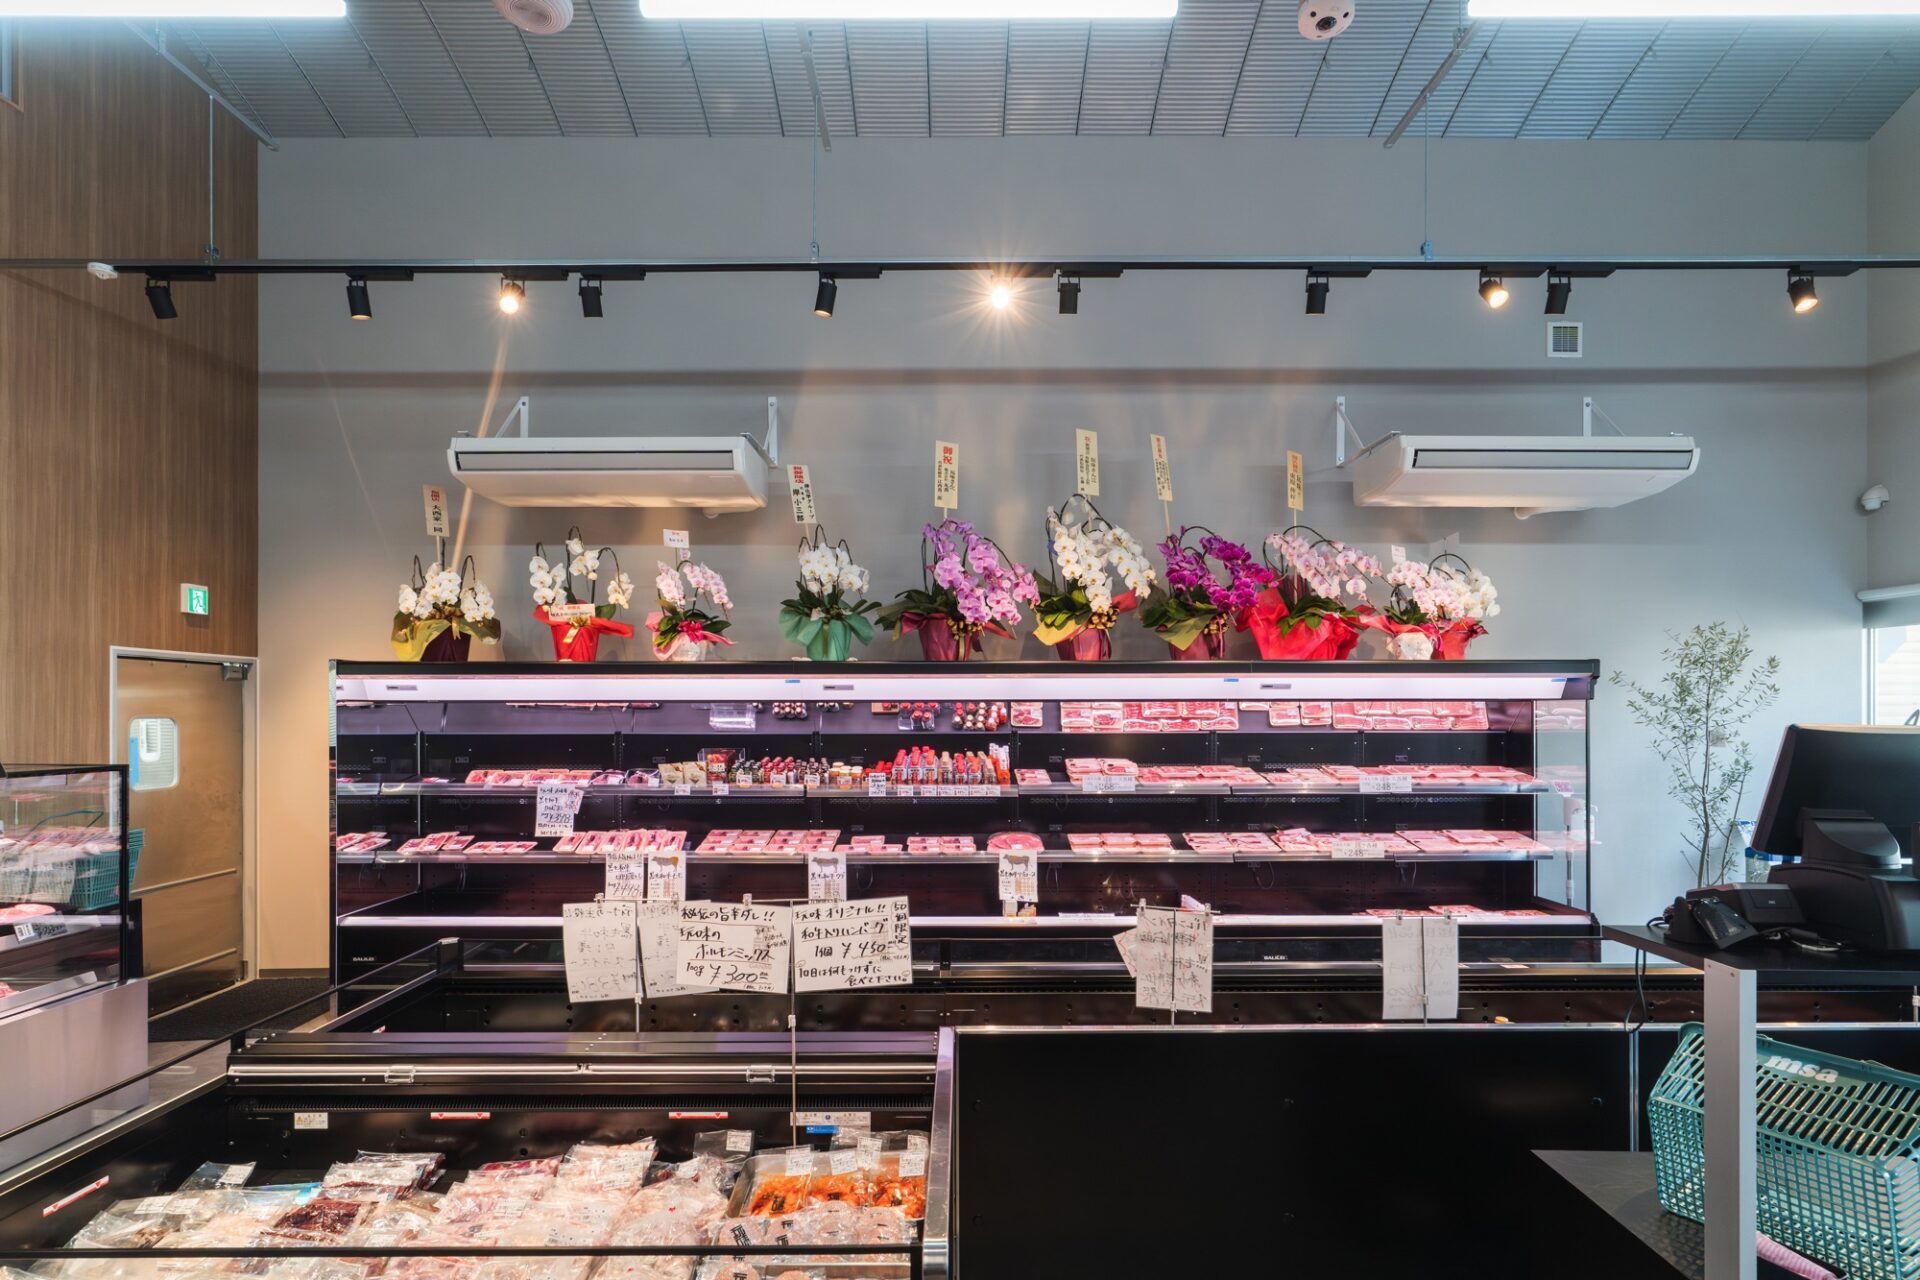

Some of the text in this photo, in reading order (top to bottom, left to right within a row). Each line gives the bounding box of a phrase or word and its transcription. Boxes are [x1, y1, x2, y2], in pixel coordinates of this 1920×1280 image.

[680, 926, 720, 941] 玩味の
[1764, 1056, 1838, 1083] msa
